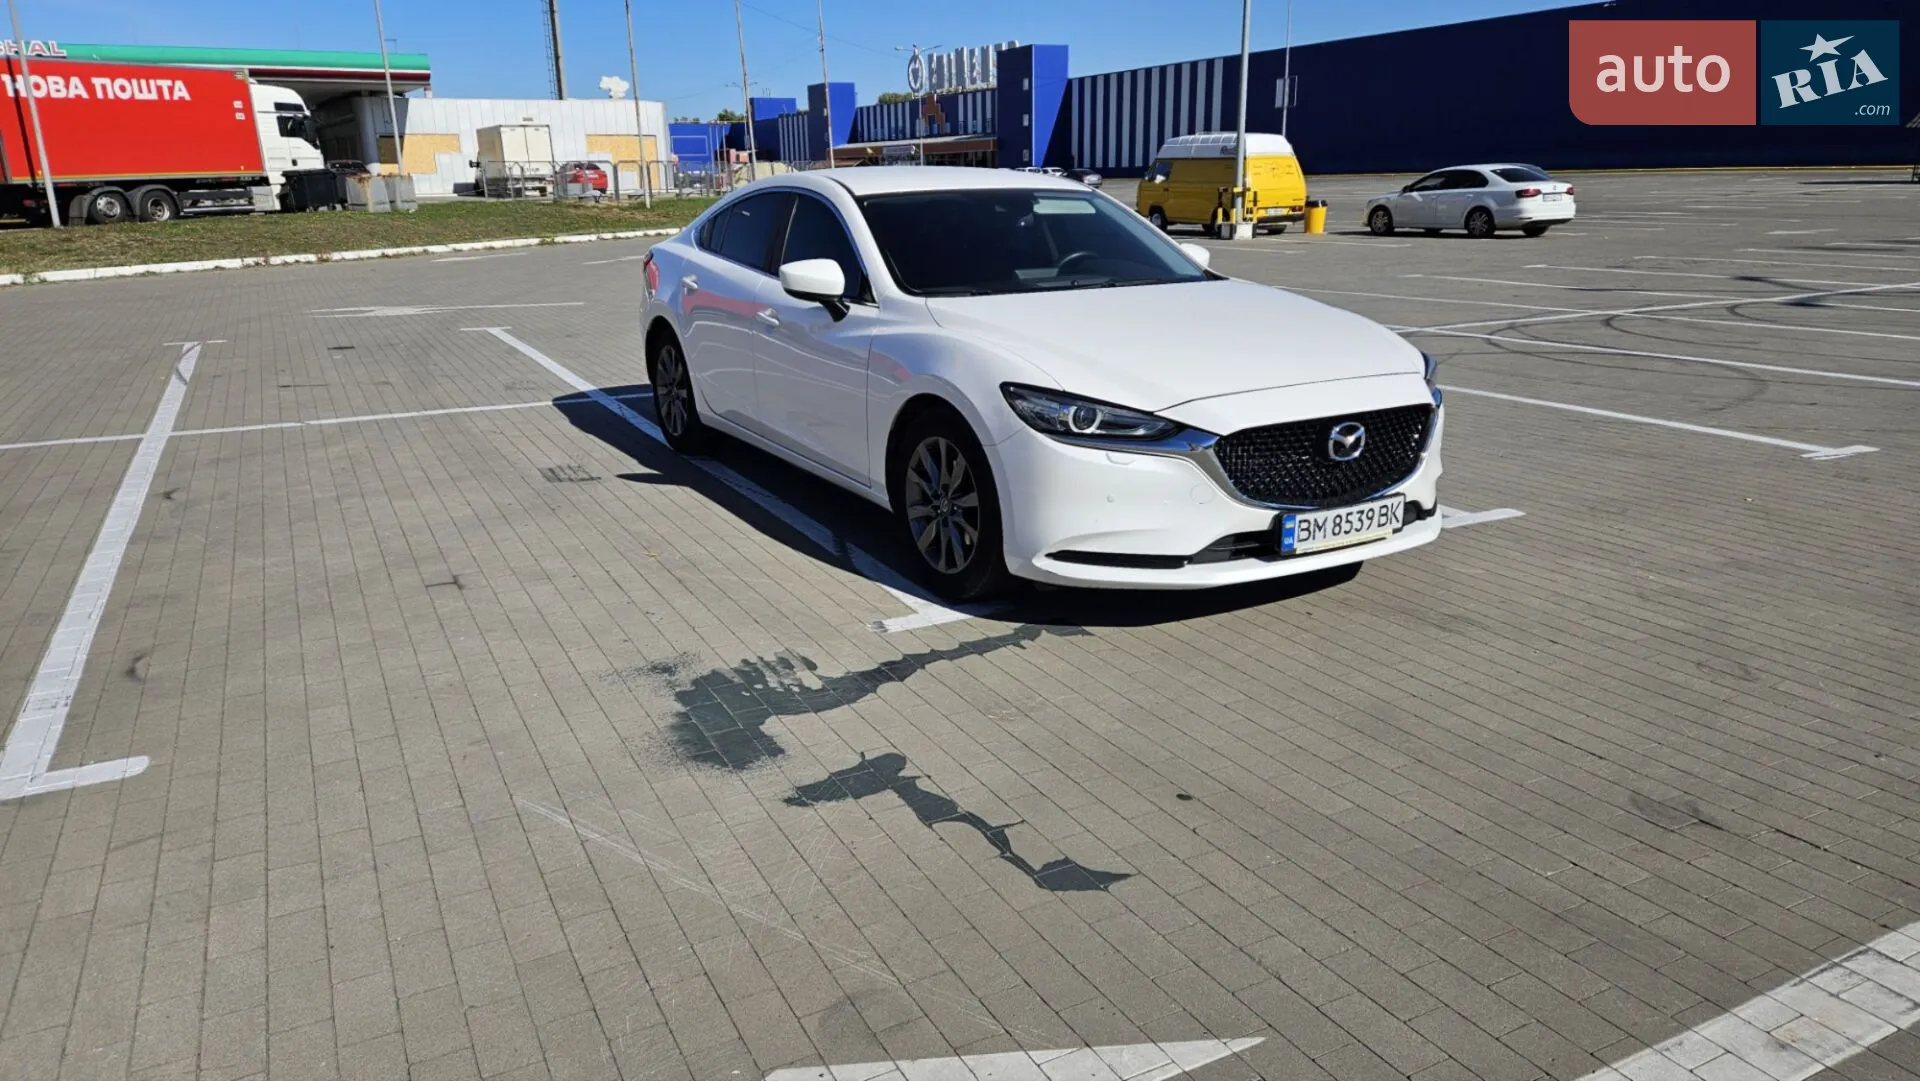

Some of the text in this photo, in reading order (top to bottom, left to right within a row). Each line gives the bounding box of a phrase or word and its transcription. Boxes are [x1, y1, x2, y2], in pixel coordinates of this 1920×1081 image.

[91, 77, 192, 101] ПОШТА
[1297, 516, 1328, 542] BM
[1332, 508, 1375, 537] 8539
[1377, 501, 1402, 528] BK
